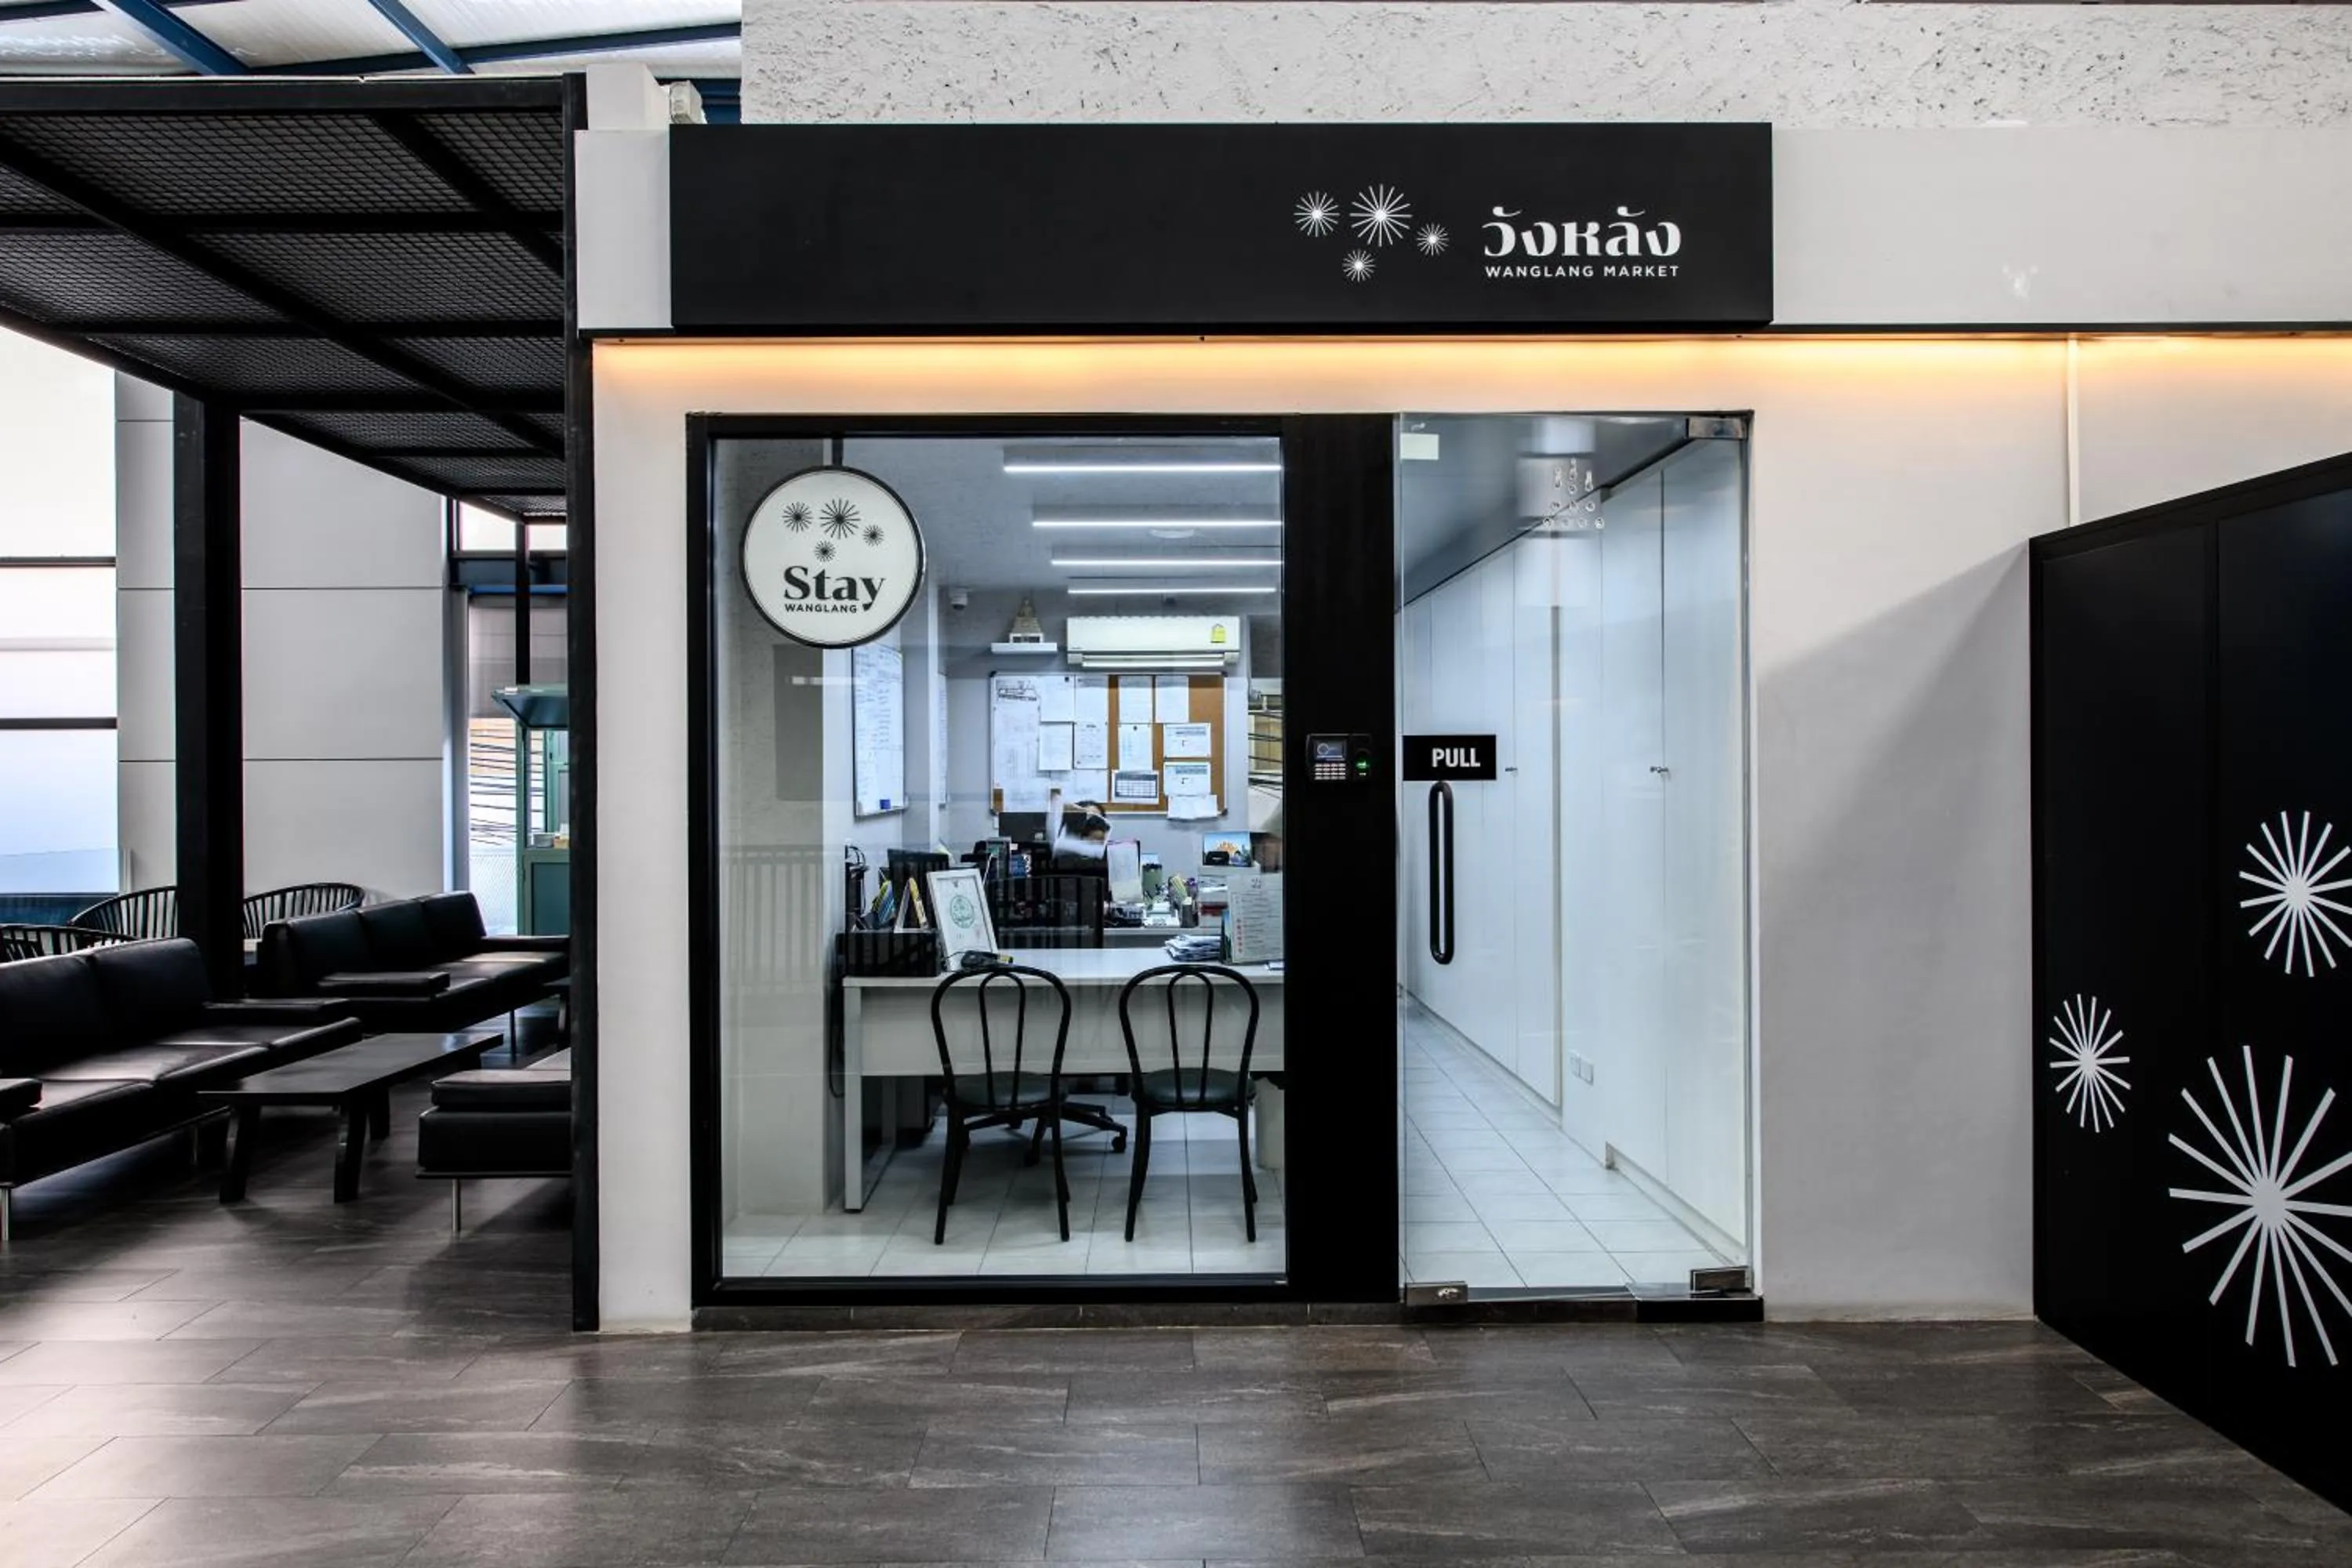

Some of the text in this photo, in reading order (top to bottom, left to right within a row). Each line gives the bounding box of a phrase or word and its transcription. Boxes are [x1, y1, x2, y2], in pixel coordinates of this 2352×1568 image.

[1482, 206, 1682, 257] วังหลัง
[1485, 265, 1679, 278] WANGLANG MARKET
[782, 565, 886, 612] Stay
[784, 603, 858, 614] WANGLANG
[1432, 747, 1481, 768] PULL
